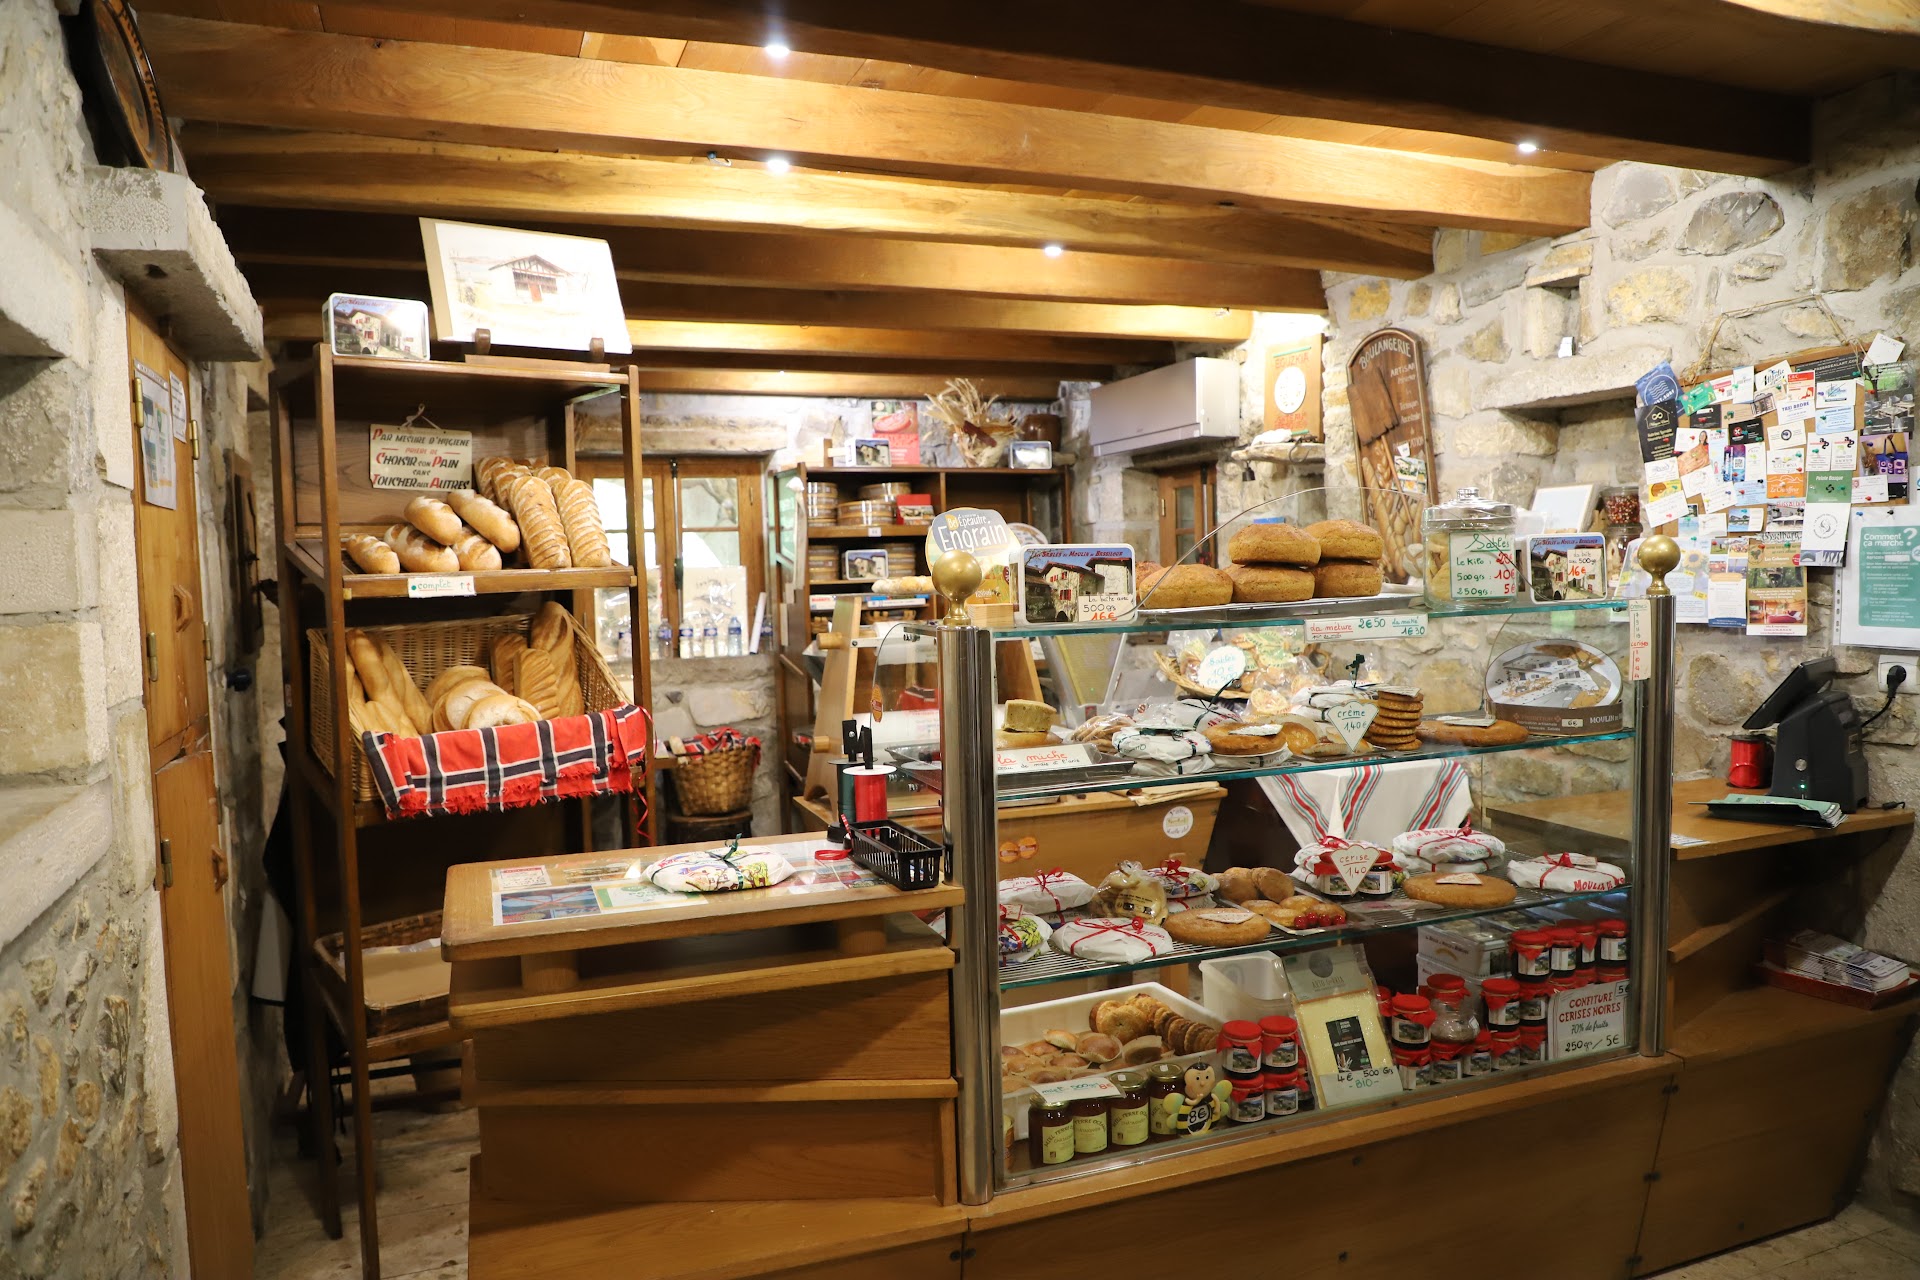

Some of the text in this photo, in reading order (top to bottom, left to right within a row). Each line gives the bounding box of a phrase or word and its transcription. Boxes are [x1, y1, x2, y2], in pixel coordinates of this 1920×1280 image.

[1359, 338, 1411, 369] BOULANGERIE
[1390, 362, 1416, 378] ARTISAN
[372, 428, 393, 441] PAR
[395, 434, 427, 444] MESURE
[376, 452, 417, 467] CHOISIR
[432, 456, 459, 469] PAIN
[372, 474, 417, 487] TOUCHER
[430, 477, 470, 490] AUTRES
[938, 521, 1008, 553] Engrain
[1864, 533, 1902, 541] Comment
[1494, 568, 1515, 580] 10€
[1568, 565, 1586, 576] 16€
[418, 578, 451, 592] complet
[1091, 612, 1117, 622] 16€
[1337, 705, 1365, 718] crème
[1590, 716, 1615, 724] MOULIN
[1026, 751, 1067, 761] miche
[1339, 852, 1370, 863] cerise
[1569, 992, 1613, 1008] CONFITURE
[1559, 1002, 1621, 1022] CERISES NOIRES
[1606, 1034, 1620, 1046] 5€
